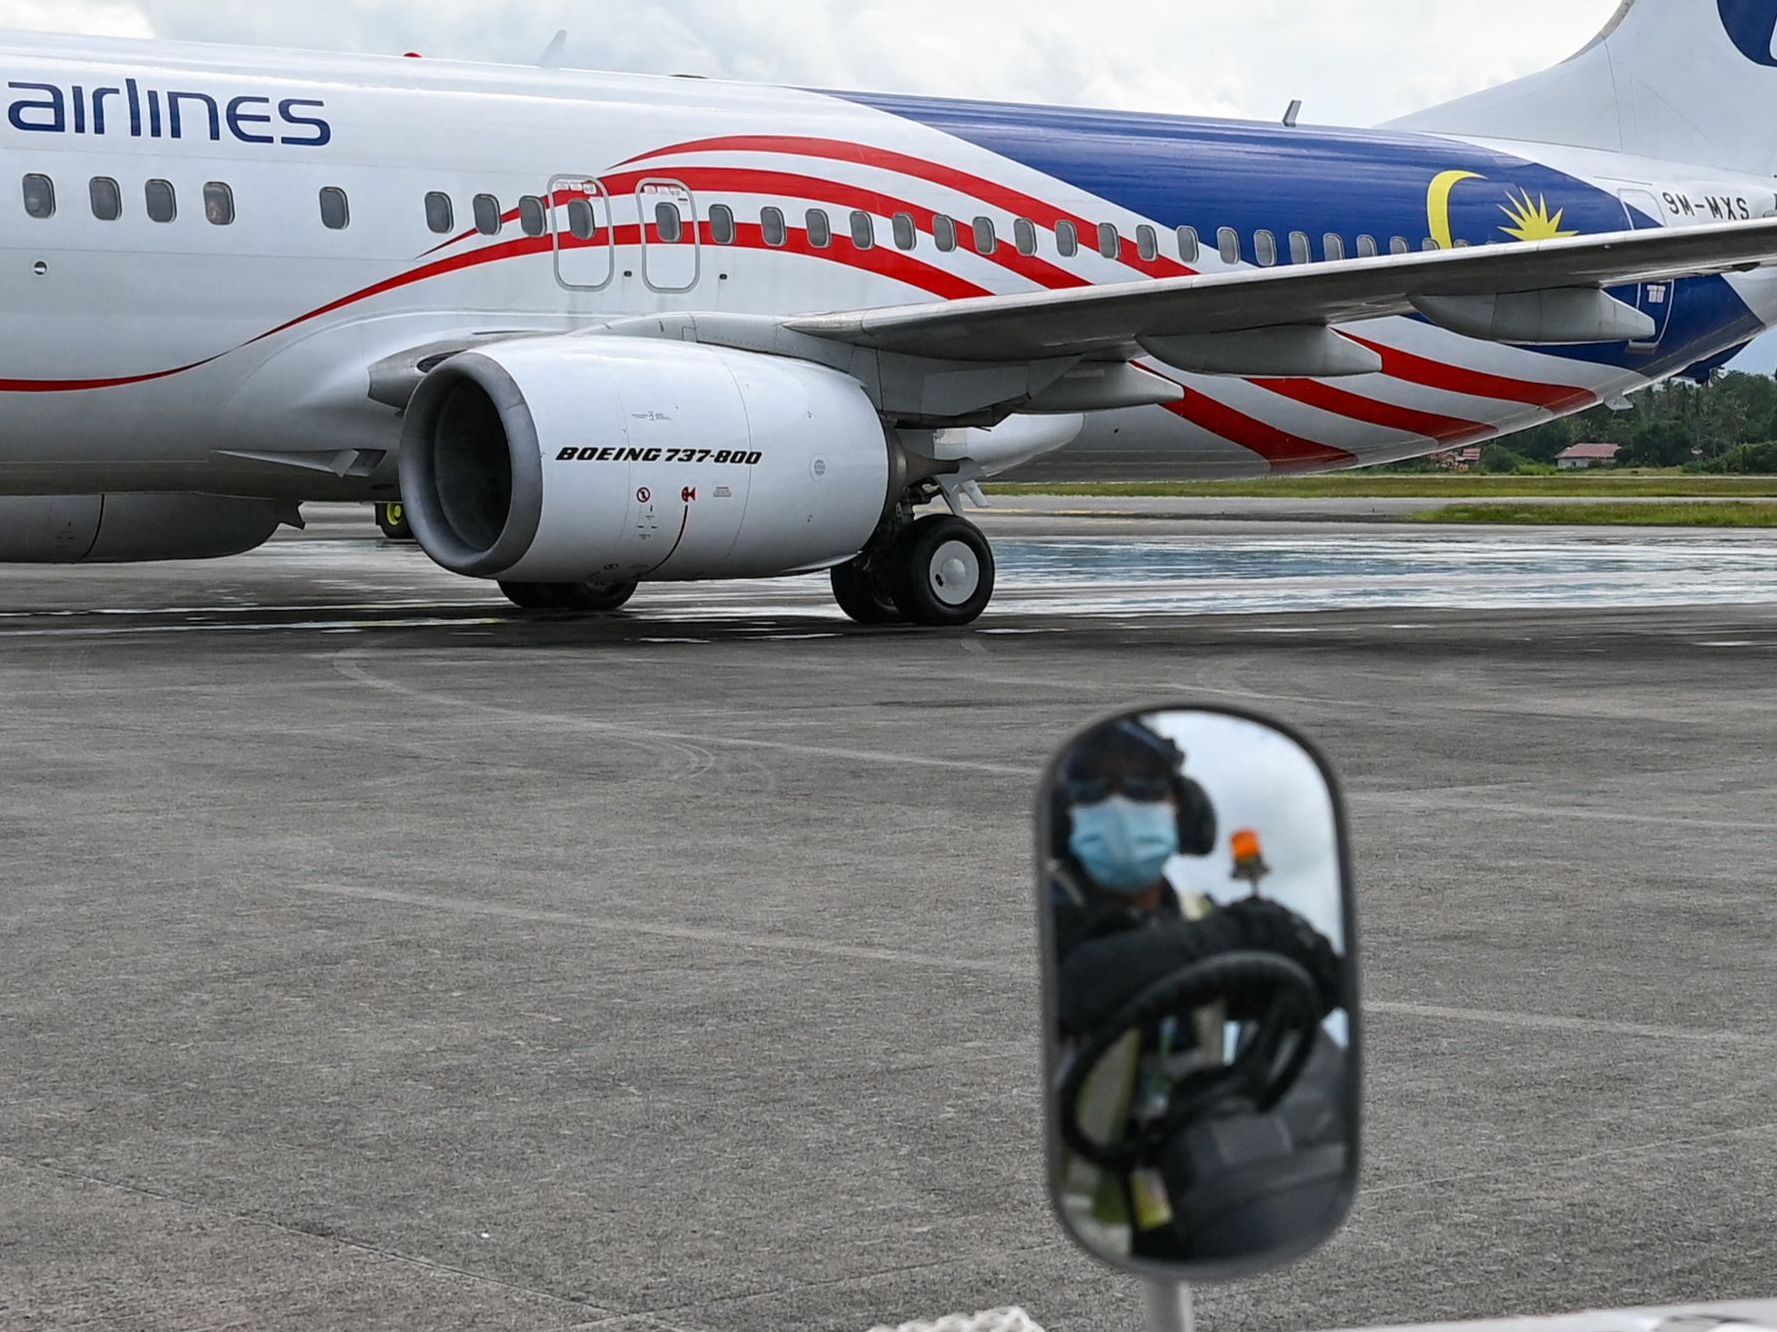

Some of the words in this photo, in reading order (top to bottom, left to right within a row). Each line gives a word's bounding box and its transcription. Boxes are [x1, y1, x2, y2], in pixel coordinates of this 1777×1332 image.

[7, 78, 332, 147] airlines
[1662, 191, 1750, 220] 9M-MXS
[555, 446, 663, 462] BOEING
[664, 448, 763, 465] 737-800
